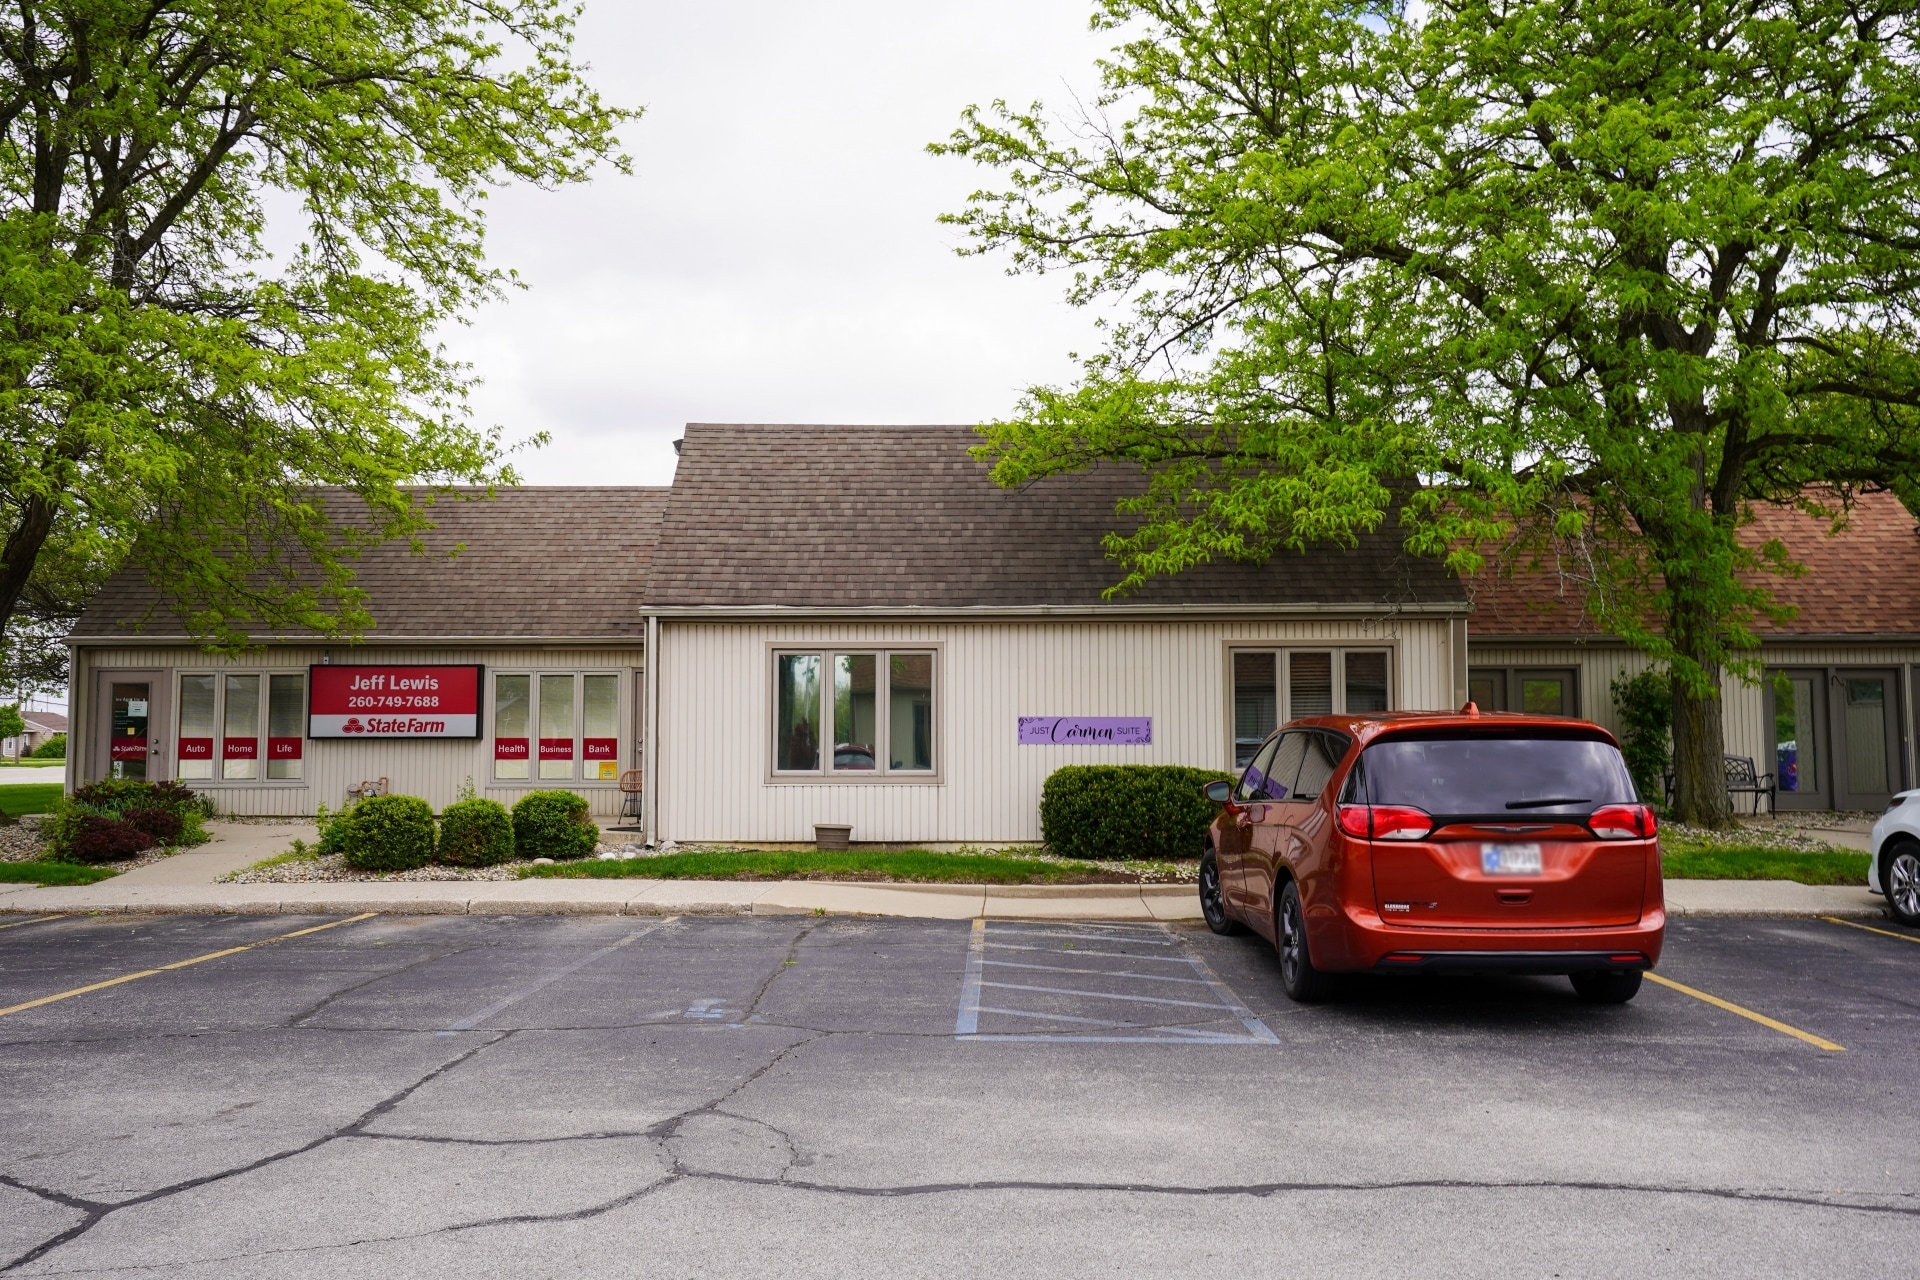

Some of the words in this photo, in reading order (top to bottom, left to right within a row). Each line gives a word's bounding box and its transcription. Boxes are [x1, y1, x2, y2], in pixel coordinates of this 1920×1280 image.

[350, 675, 385, 690] Jeff
[390, 675, 439, 690] Lewis
[348, 696, 439, 708] 260-749-7688
[1029, 726, 1050, 735] JUST
[1051, 717, 1115, 743] Carmen
[1116, 726, 1141, 735] SUITE
[186, 744, 206, 753] Auto
[228, 744, 253, 753] Home
[276, 744, 293, 753] Life
[498, 744, 526, 753] Health
[540, 745, 572, 753] Business
[588, 744, 610, 753] Bank
